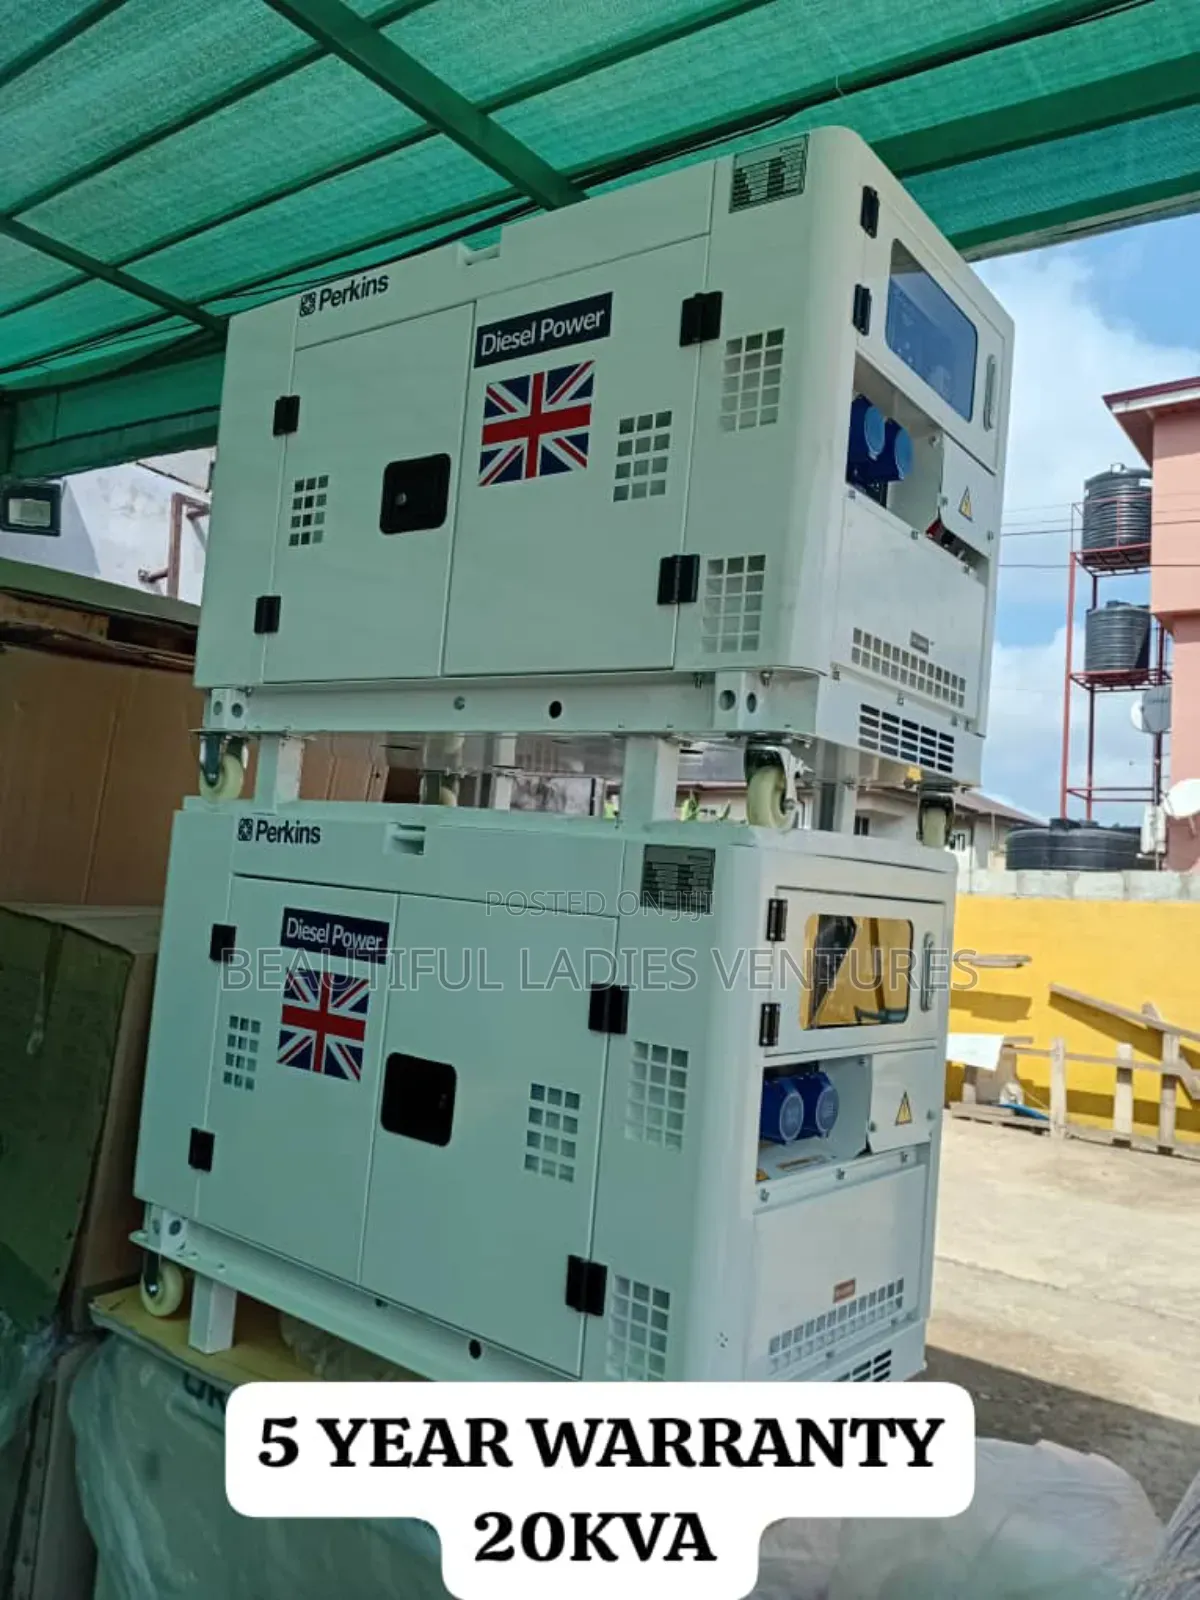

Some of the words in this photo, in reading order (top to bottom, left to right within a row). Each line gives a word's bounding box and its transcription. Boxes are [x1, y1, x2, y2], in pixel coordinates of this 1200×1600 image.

[319, 275, 389, 311] Perkins
[481, 321, 537, 356] Diesel
[540, 309, 605, 341] Power
[256, 820, 321, 844] Perkins
[286, 917, 330, 944] Diesel
[332, 924, 384, 952] Power
